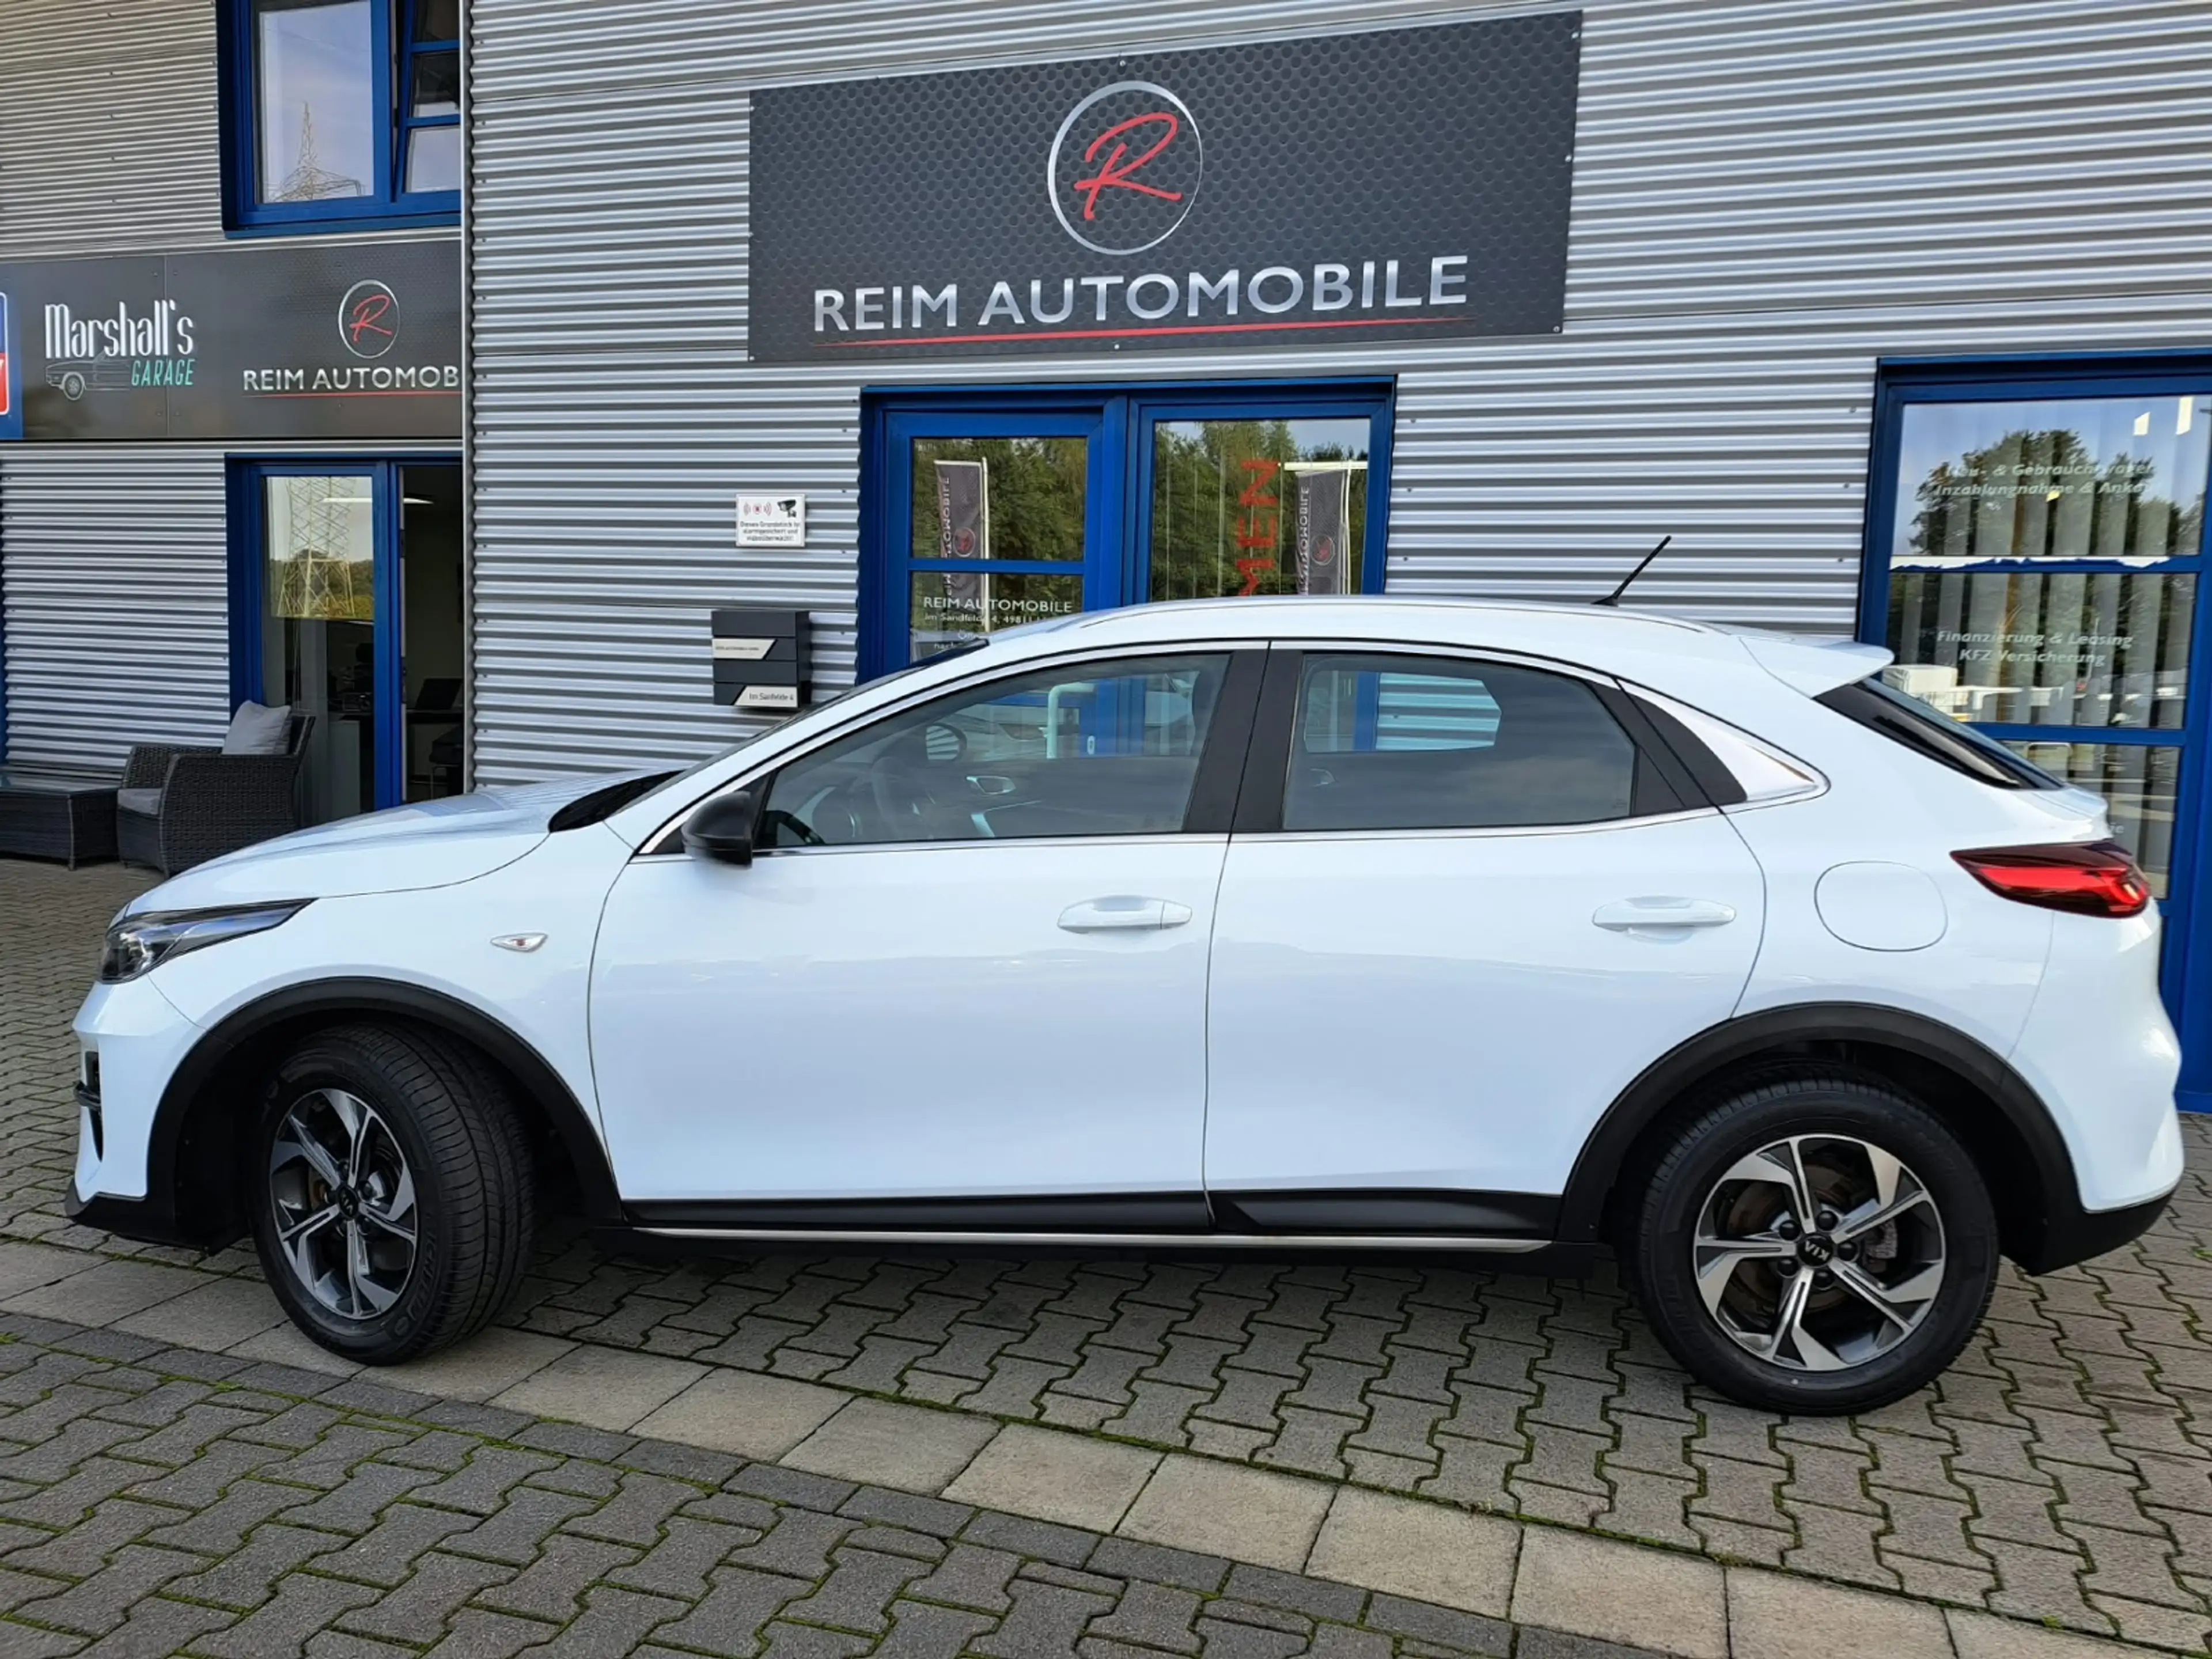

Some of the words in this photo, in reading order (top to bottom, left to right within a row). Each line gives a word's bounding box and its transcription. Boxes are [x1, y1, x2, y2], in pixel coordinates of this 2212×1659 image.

[815, 284, 957, 331] REIM
[978, 256, 1468, 326] AUTOMOBILE
[45, 299, 195, 358] Marshall's
[131, 359, 195, 386] GARAGE
[243, 369, 304, 391] REIM
[312, 365, 459, 389] AUTOMOB
[923, 597, 960, 608] REIM
[964, 599, 1073, 613] AUTOMOBILE
[940, 612, 987, 623] Sandfeld
[1959, 649, 1993, 661] KFZ
[1804, 1240, 1831, 1262] KIA
